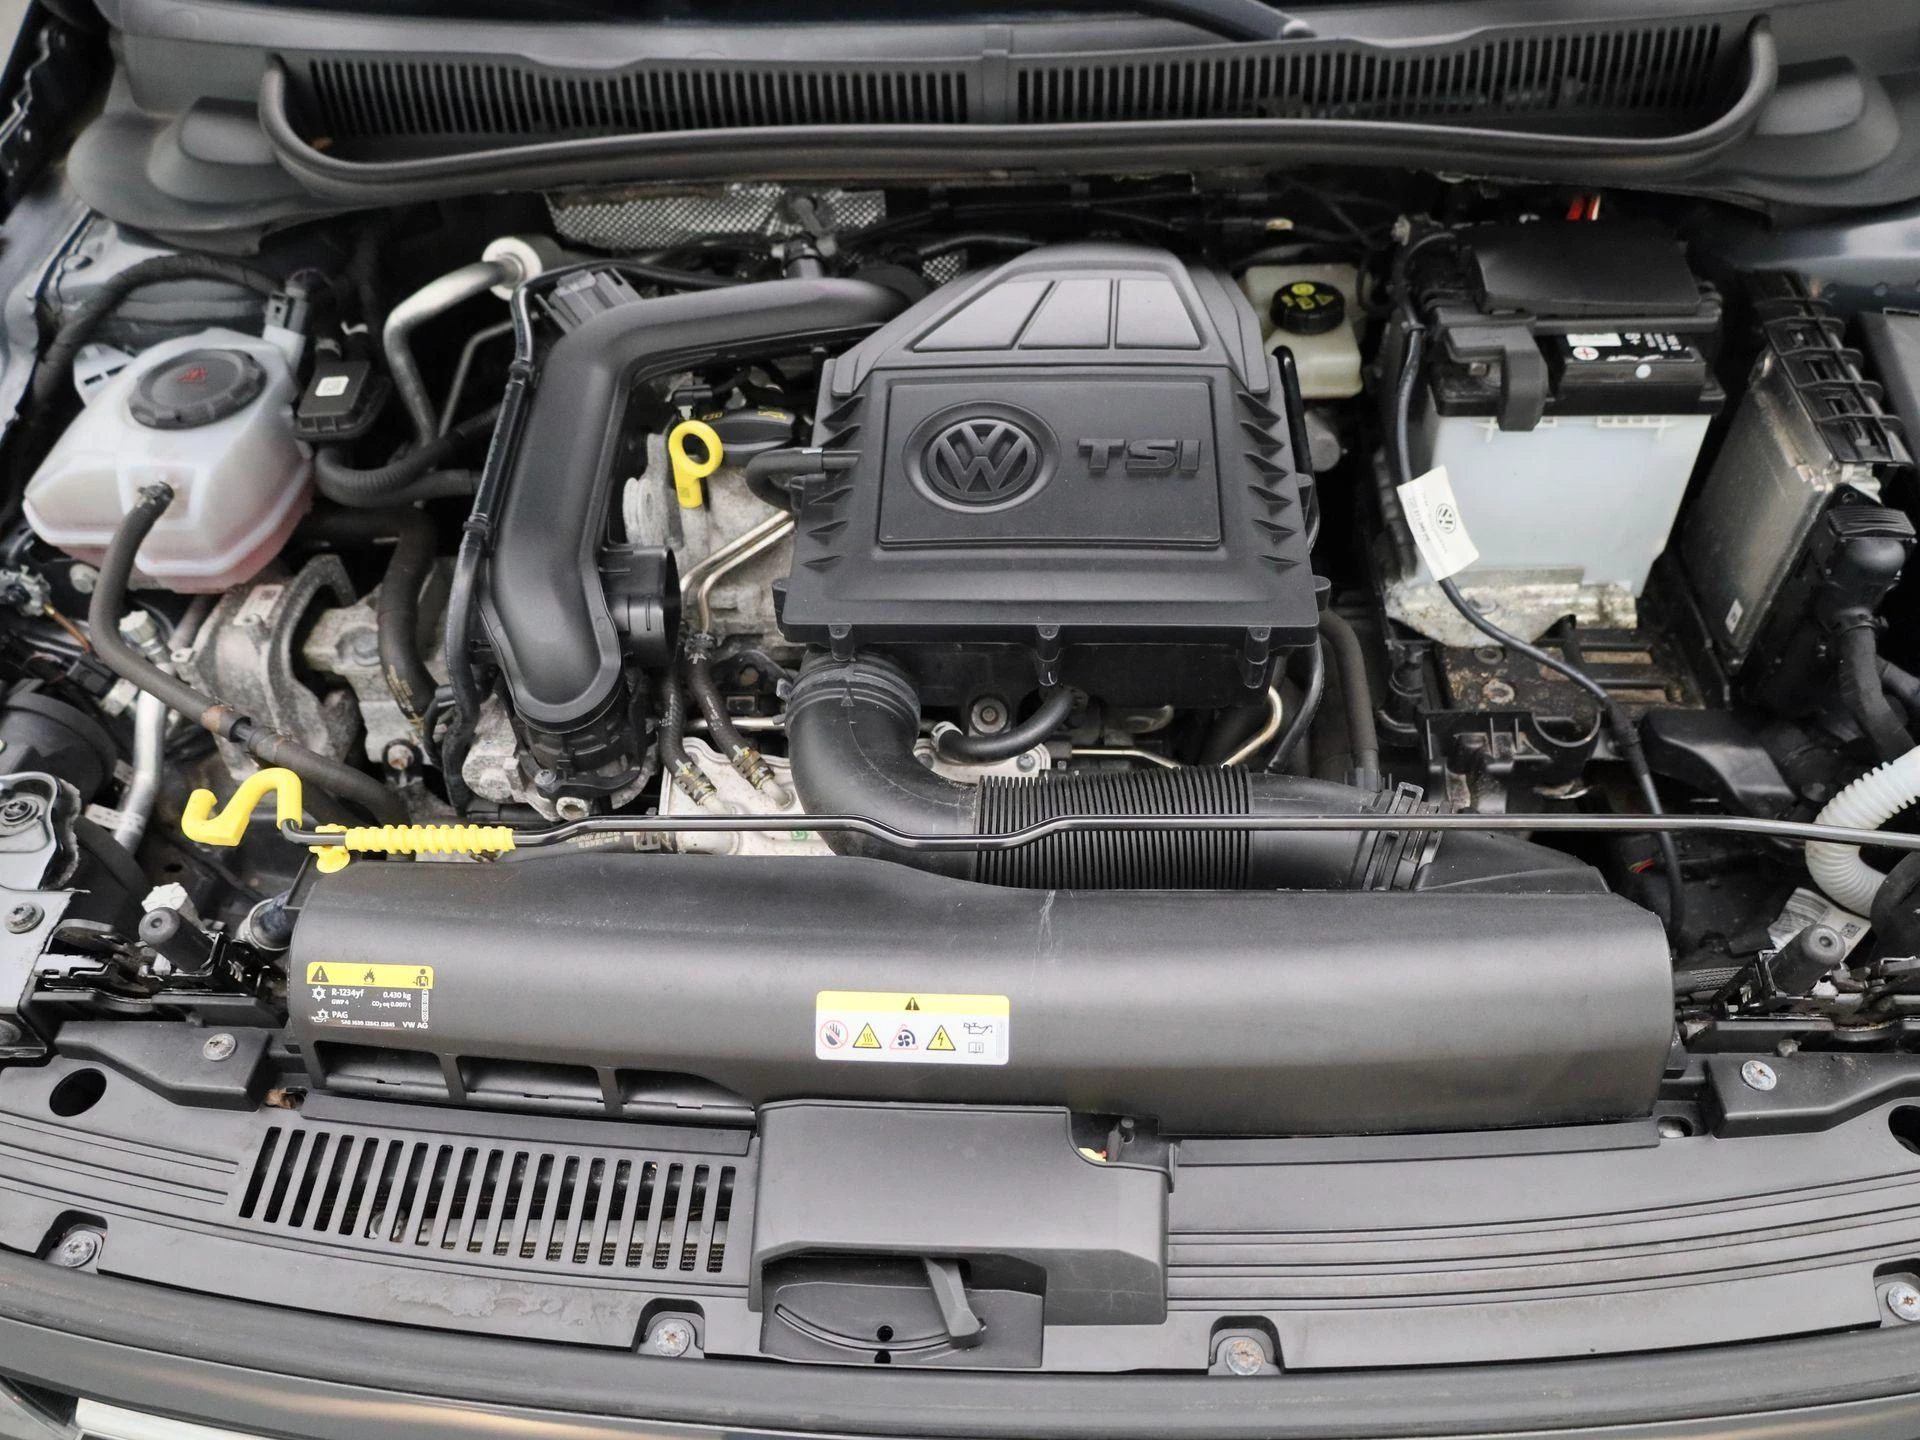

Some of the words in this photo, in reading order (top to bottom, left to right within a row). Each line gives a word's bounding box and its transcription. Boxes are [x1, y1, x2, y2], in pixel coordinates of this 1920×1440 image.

[1078, 438, 1200, 472] TSI
[331, 988, 364, 998] R-1234yf
[402, 992, 412, 1000] kg
[331, 1011, 348, 1019] PAG
[417, 1021, 429, 1029] AG
